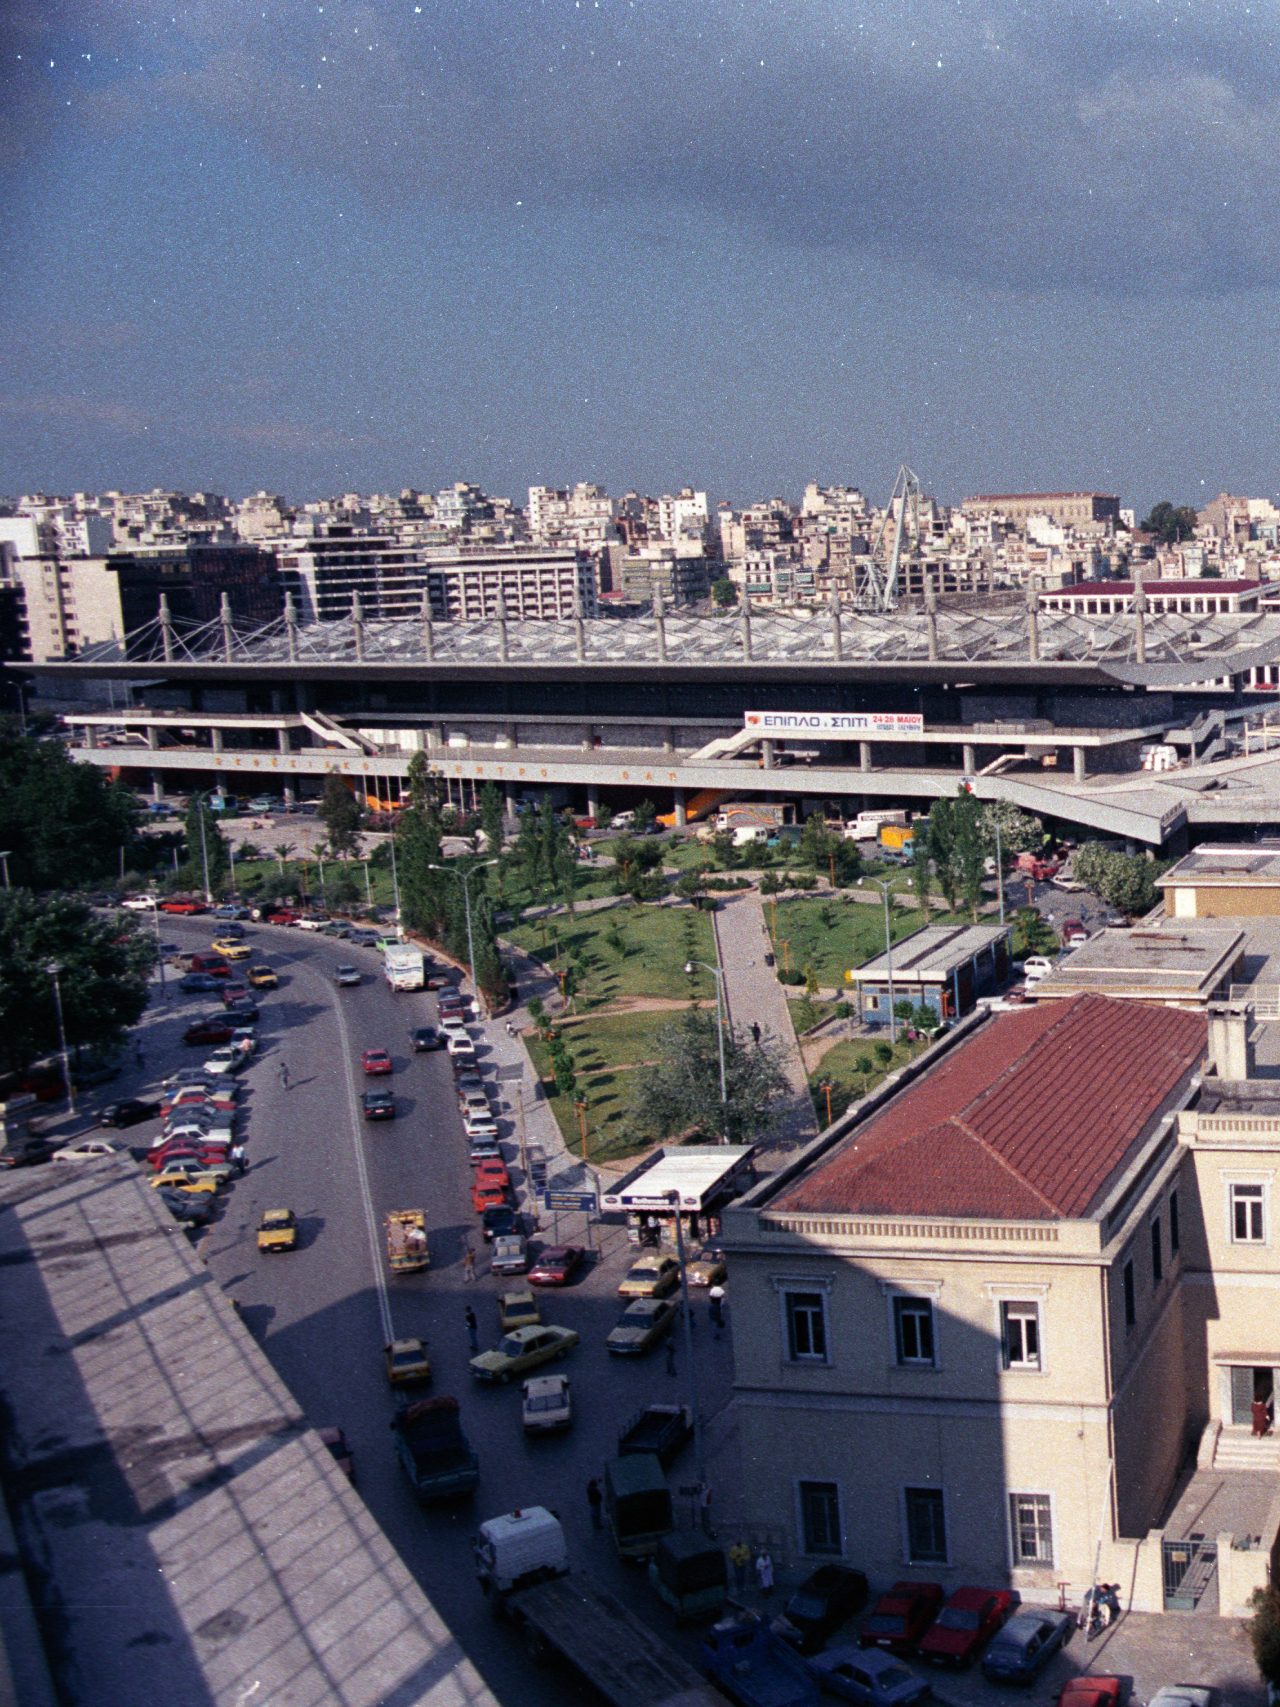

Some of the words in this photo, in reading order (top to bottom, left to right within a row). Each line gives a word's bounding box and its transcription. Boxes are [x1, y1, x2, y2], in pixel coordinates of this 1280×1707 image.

[764, 715, 820, 727] ΕΠΙΠΛΟ
[831, 717, 868, 728] ΣΠΙΤΙ
[896, 716, 921, 724] ΜΑΙΟΥ
